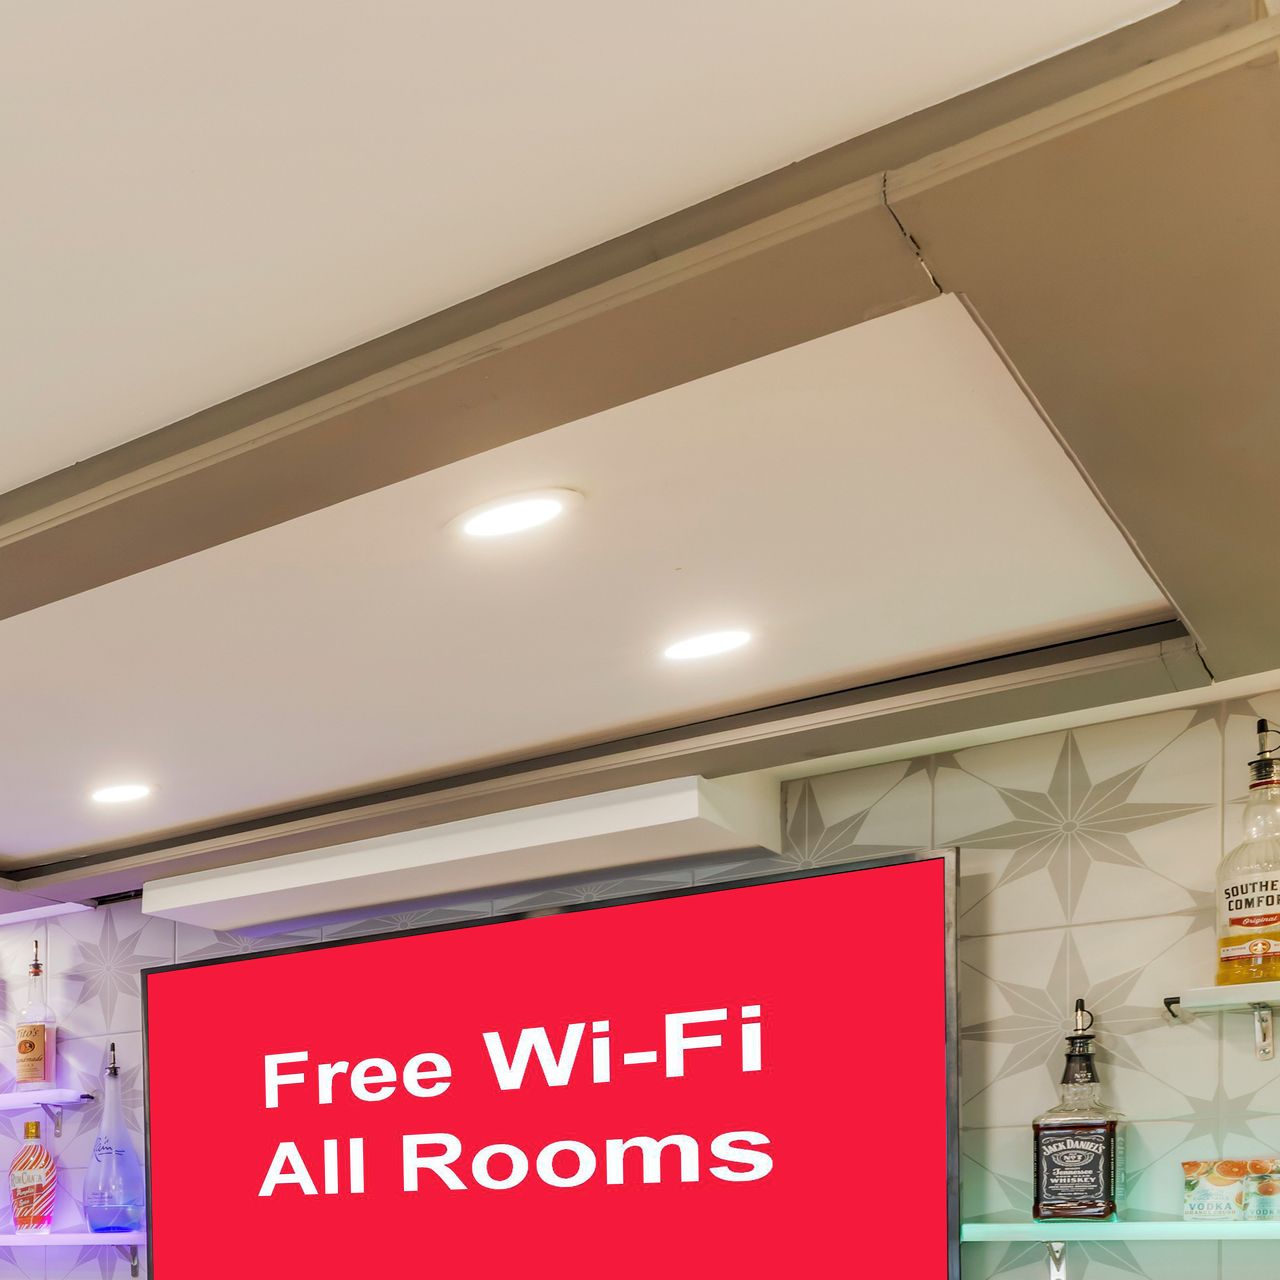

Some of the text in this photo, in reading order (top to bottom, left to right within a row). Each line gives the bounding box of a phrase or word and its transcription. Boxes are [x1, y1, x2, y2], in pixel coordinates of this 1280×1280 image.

[1224, 880, 1279, 899] SOUTHE
[263, 1004, 762, 1109] Free Wi-Fi
[1042, 1139, 1106, 1156] JACK DANIEL'S
[257, 1129, 774, 1197] All Rooms
[1052, 1168, 1093, 1176] Tennessee
[1189, 1202, 1232, 1210] VODKA
